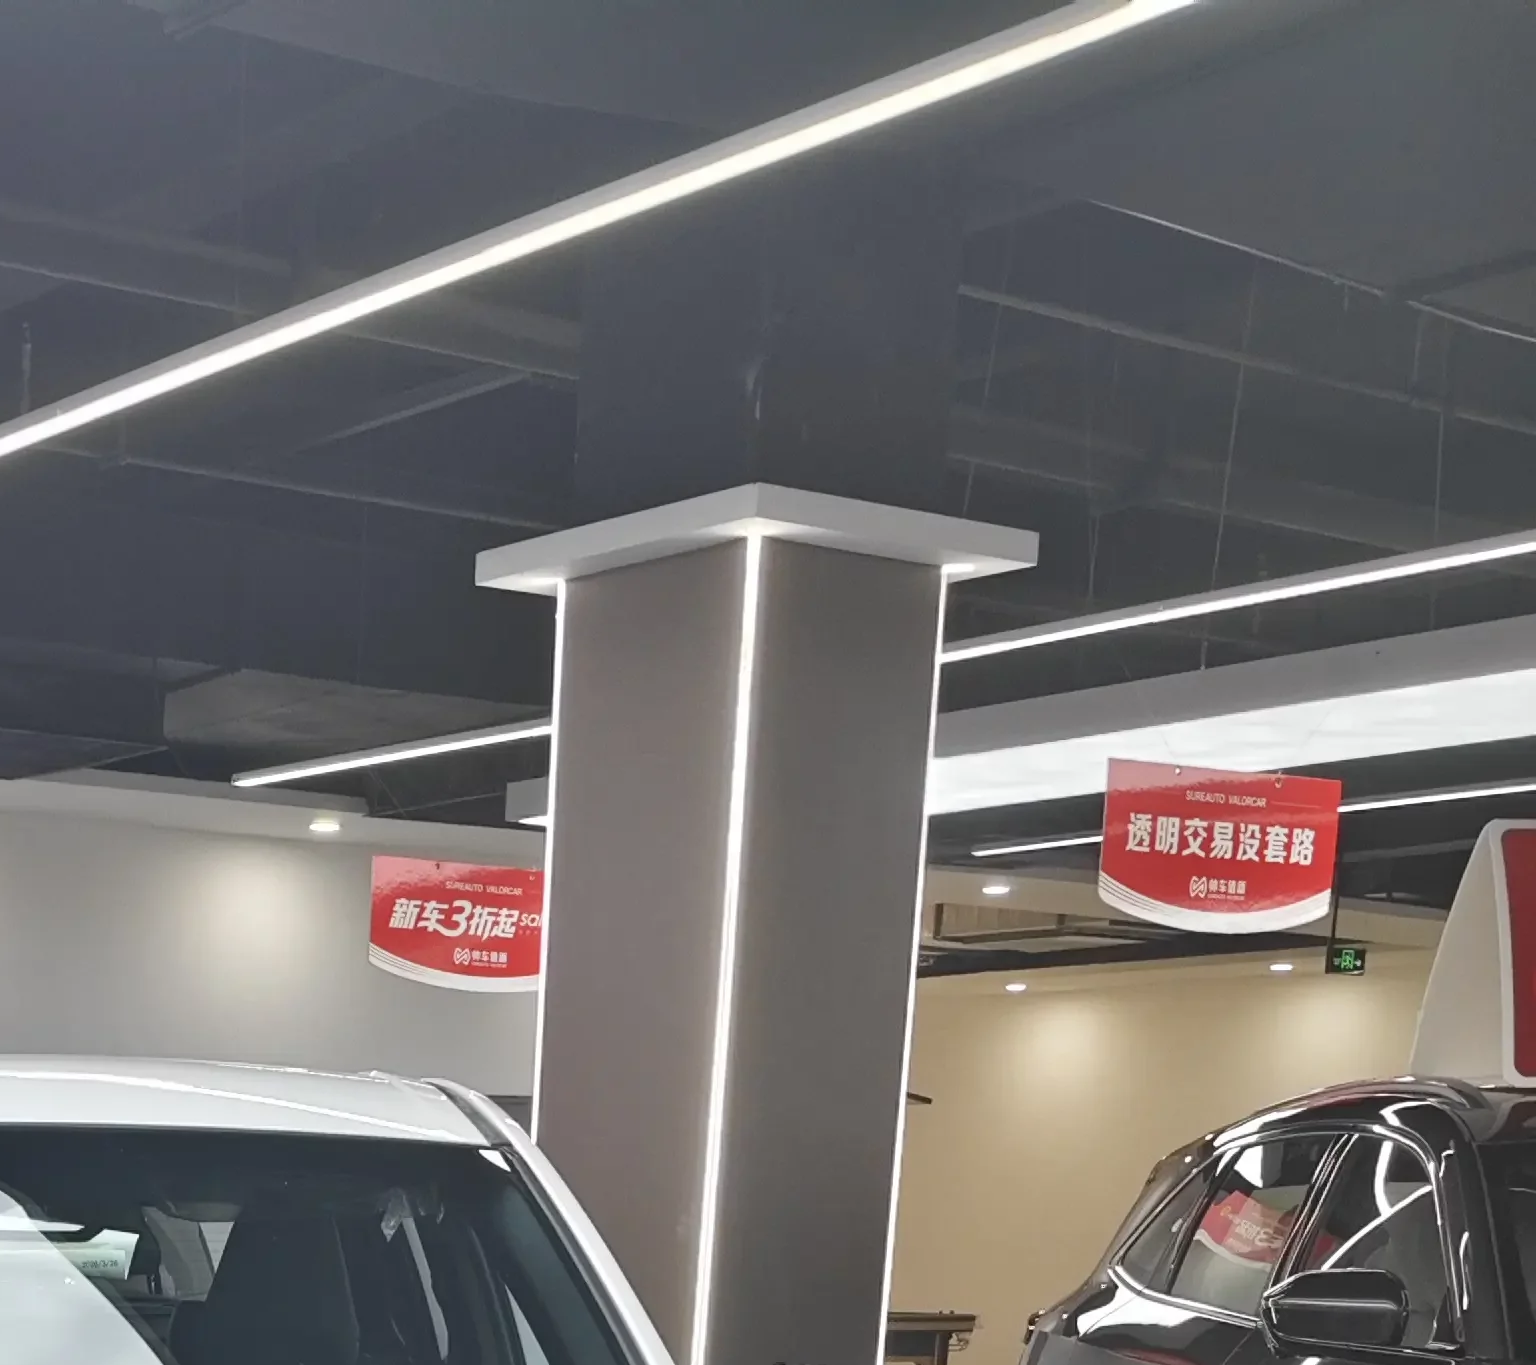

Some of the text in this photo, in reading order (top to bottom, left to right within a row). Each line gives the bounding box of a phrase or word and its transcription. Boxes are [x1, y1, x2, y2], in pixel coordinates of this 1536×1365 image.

[1186, 790, 1267, 808] SUREAUTO VALORCAR
[1125, 812, 1316, 866] 透明交易没套路
[389, 897, 520, 941] 新车3折起
